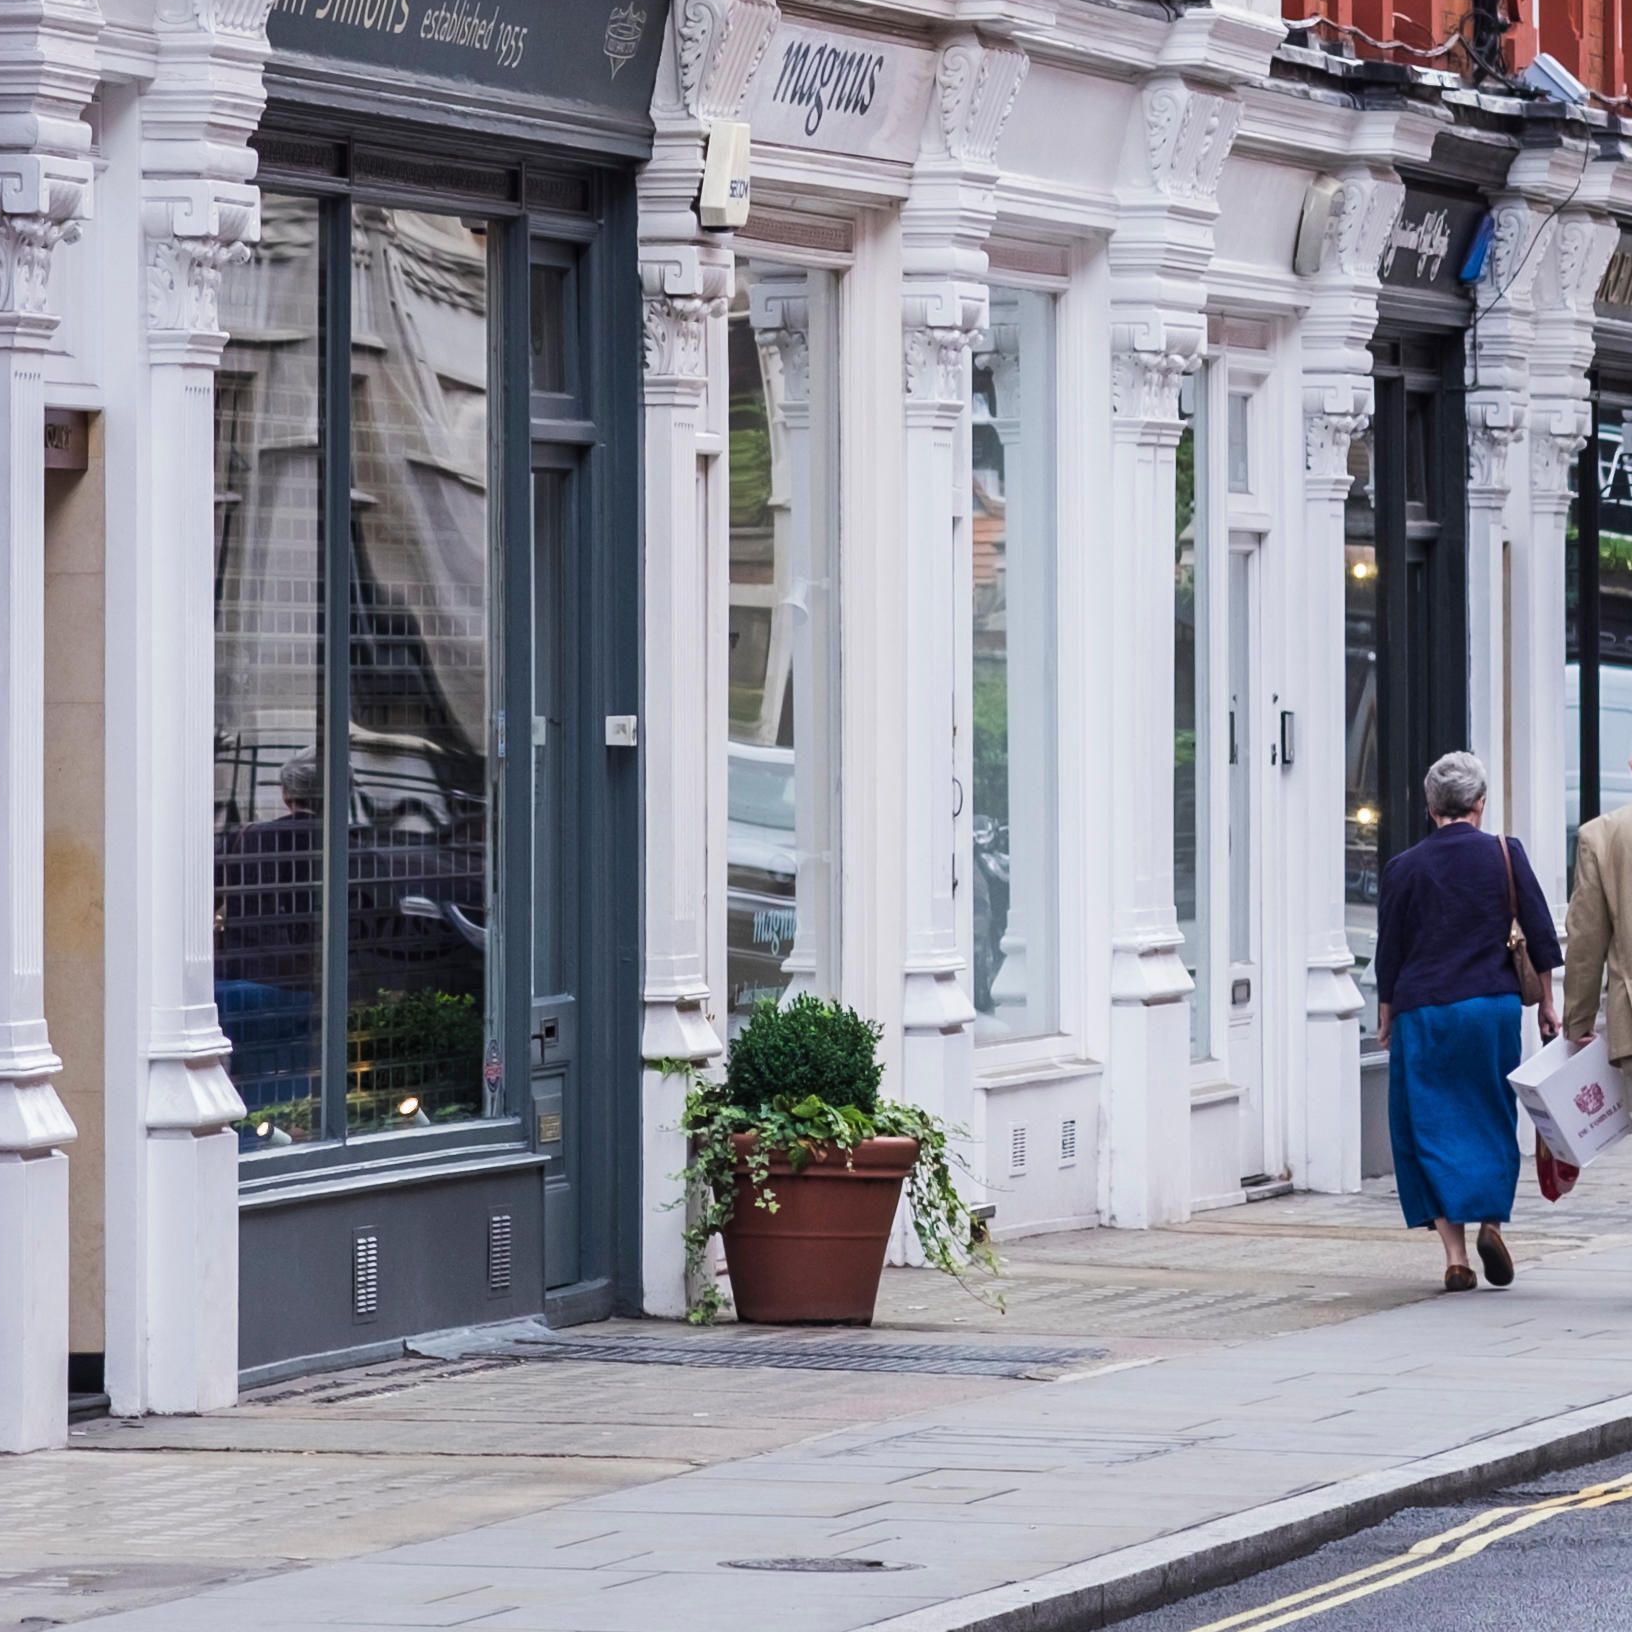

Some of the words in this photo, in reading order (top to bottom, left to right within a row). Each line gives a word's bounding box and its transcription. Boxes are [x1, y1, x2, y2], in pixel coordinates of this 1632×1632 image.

[420, 0, 500, 52] established
[494, 22, 529, 68] 1955
[772, 40, 885, 136] magnus
